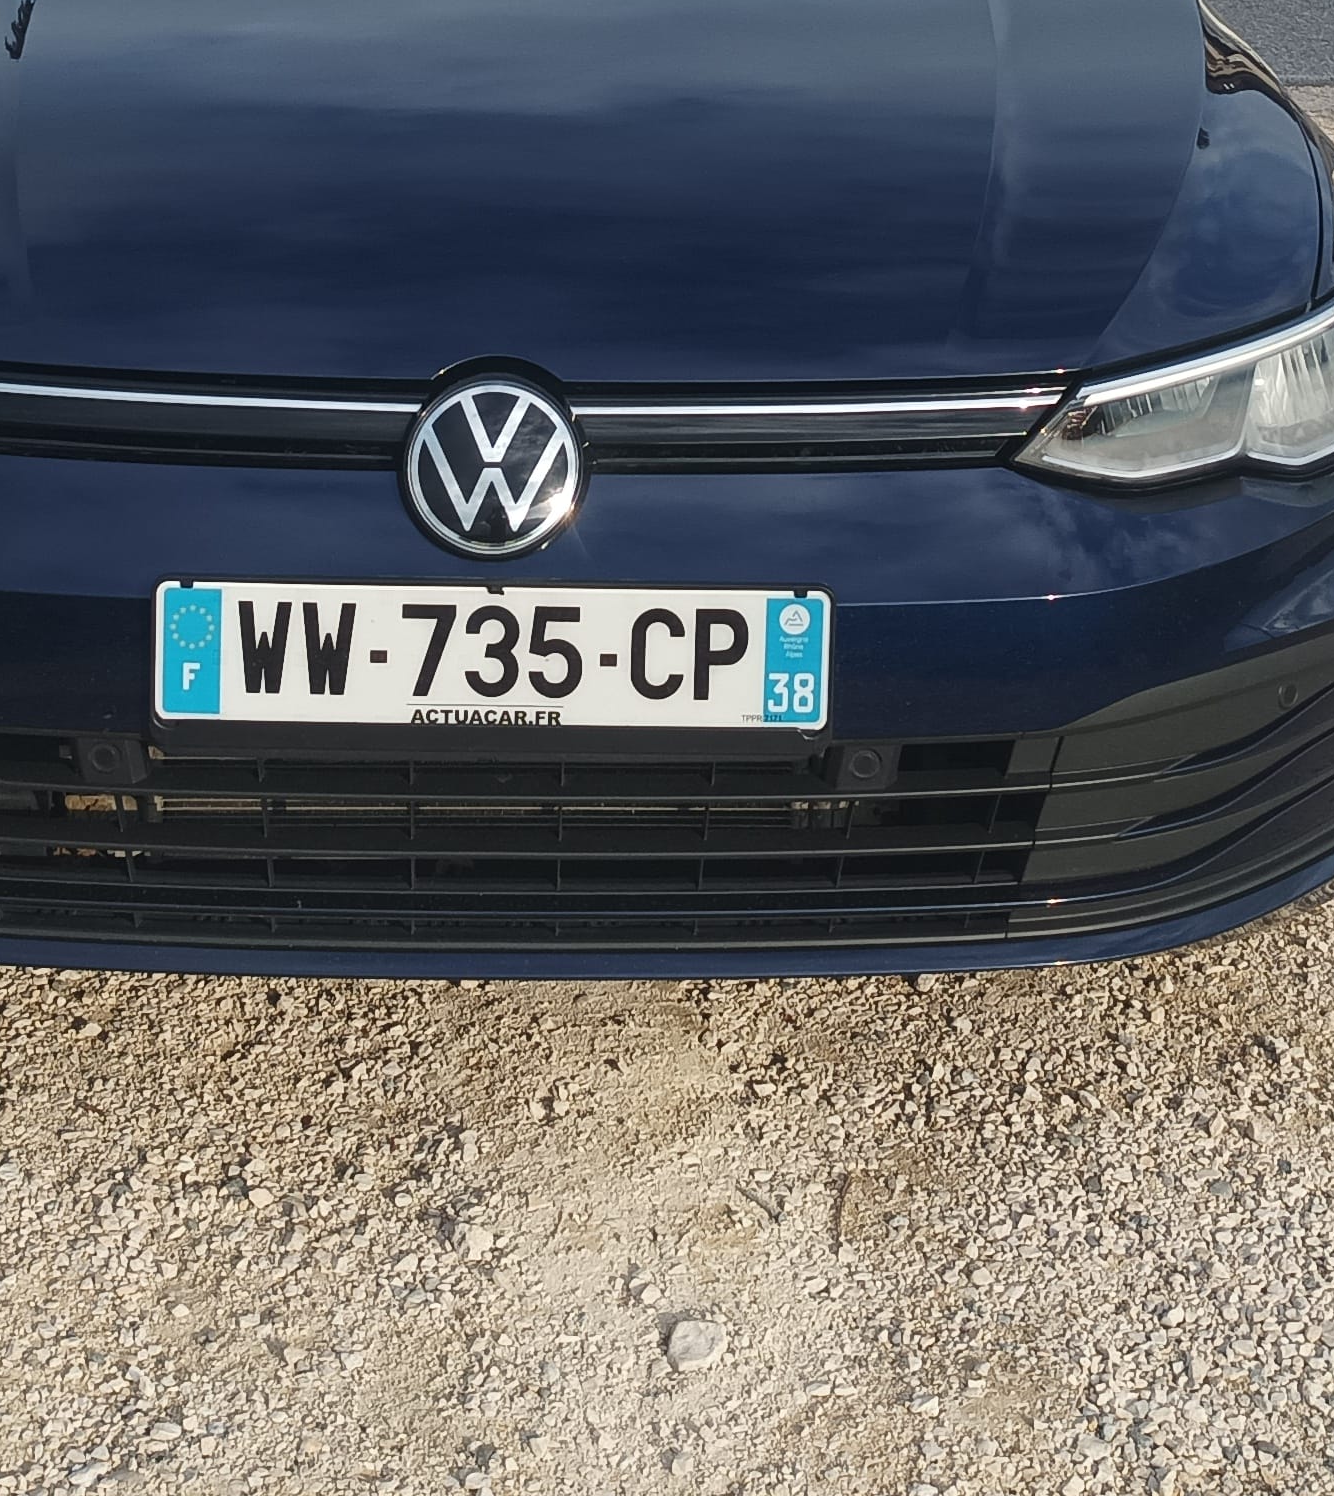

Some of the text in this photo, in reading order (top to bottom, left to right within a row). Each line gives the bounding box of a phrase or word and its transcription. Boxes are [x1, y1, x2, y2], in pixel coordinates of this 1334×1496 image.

[237, 600, 749, 701] WW-735-CP
[779, 635, 809, 644] Auvergne
[182, 662, 201, 691] F
[767, 672, 815, 714] 38
[411, 708, 562, 727] ACTUACAR.FR
